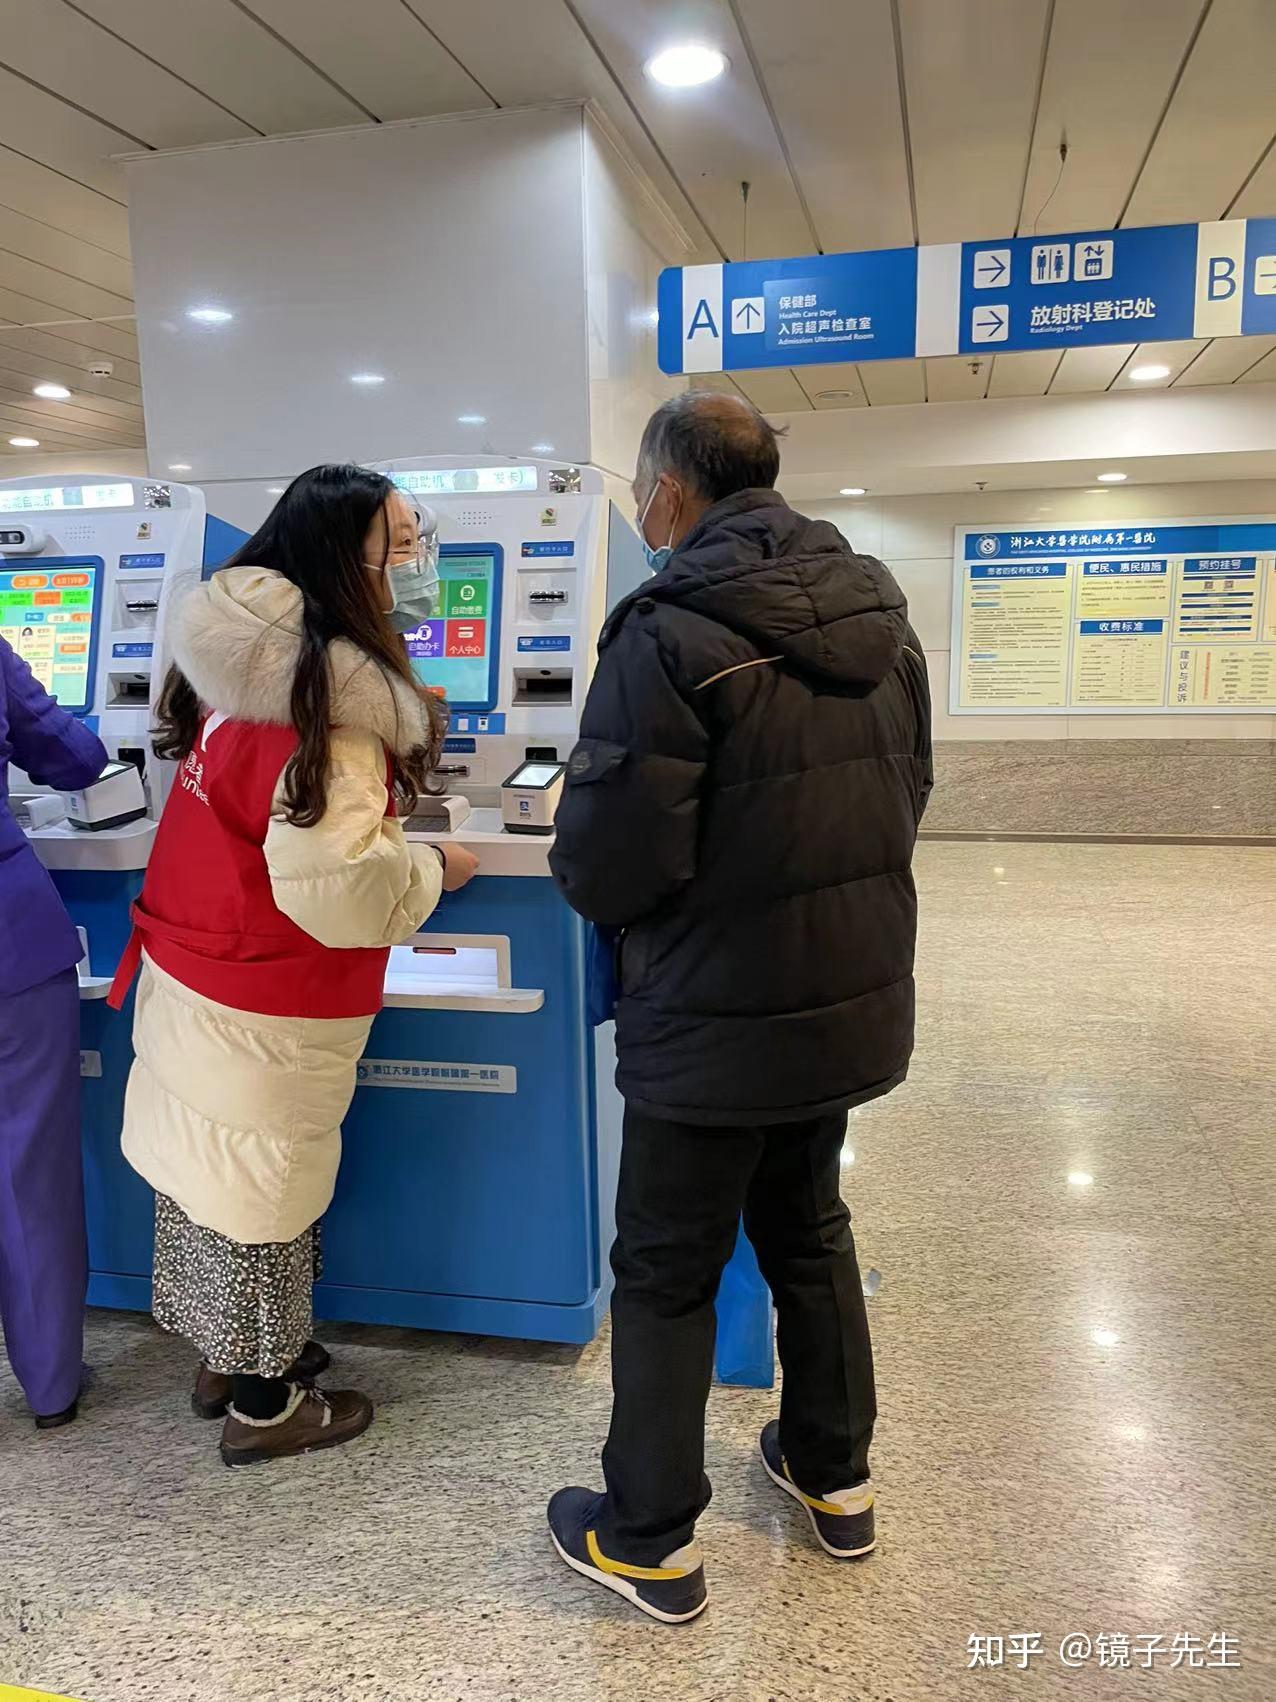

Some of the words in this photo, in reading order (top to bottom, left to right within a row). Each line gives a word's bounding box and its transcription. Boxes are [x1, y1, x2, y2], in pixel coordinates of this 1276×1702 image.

[1207, 256, 1236, 302] B
[779, 295, 817, 309] 保健部
[779, 312, 801, 320] Health
[819, 309, 837, 318] Dept
[1030, 298, 1156, 327] 放射科登记处
[687, 299, 719, 340] A
[778, 317, 872, 336] 入院超声检查室
[1029, 326, 1064, 334] Radiology
[1065, 324, 1084, 333] Dept
[778, 337, 814, 346] Admission
[814, 334, 853, 343] Ultrasound
[853, 333, 875, 341] Room
[1089, 561, 1162, 574] 便民、惠民措施
[1198, 559, 1242, 571] 预约挂号
[1098, 621, 1145, 632] 收费标准
[449, 645, 481, 655] 个人中心
